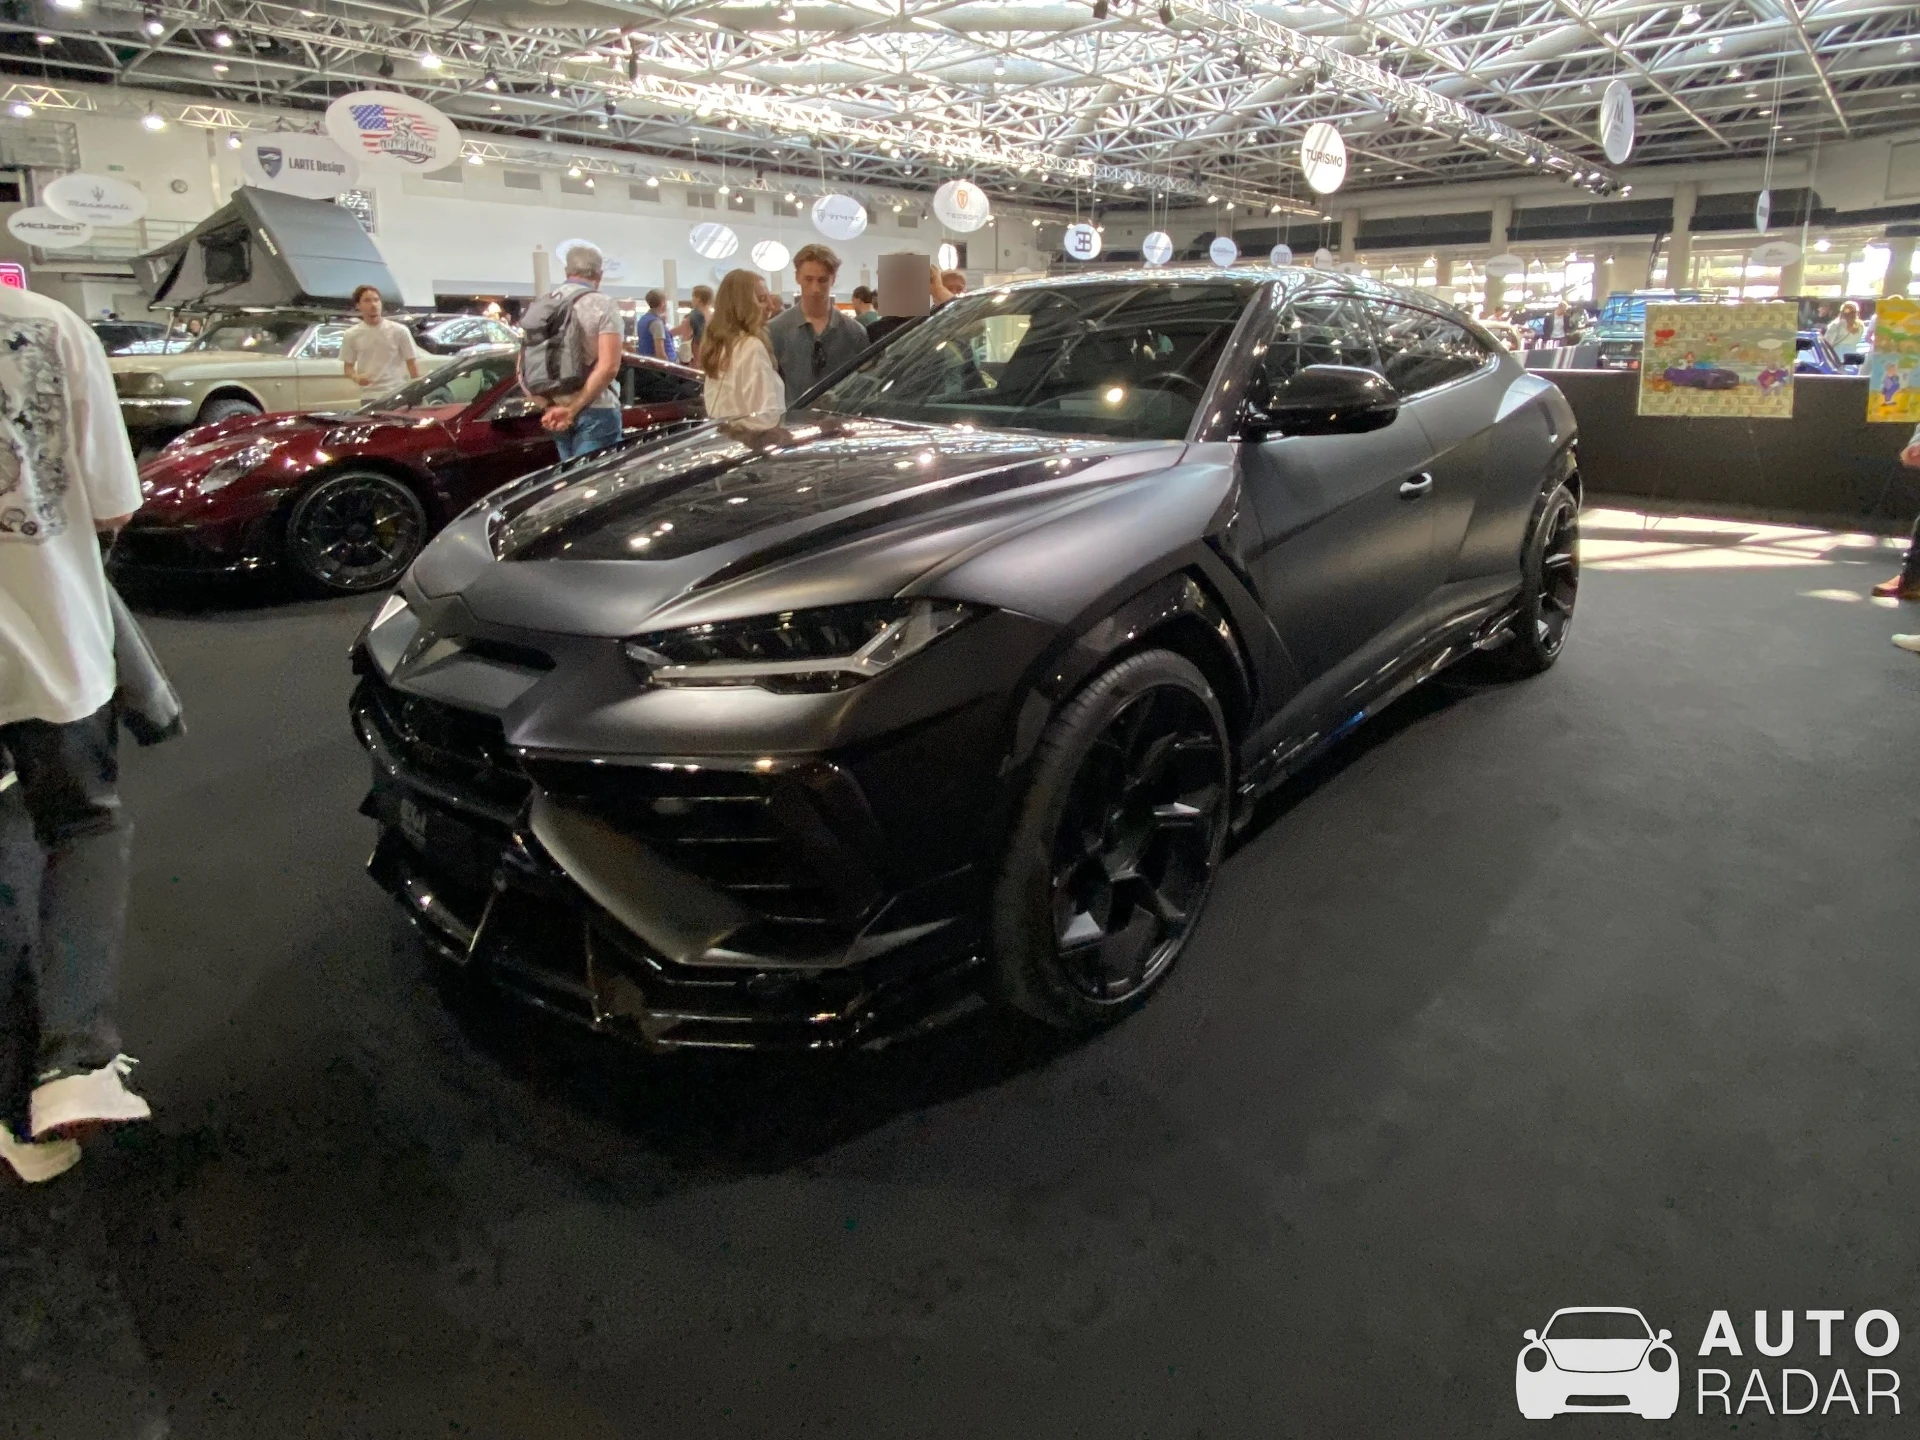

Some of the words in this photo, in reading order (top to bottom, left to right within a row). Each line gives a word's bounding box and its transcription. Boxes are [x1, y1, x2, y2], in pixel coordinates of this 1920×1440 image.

[289, 158, 315, 170] LARTE
[316, 161, 346, 175] Design
[1306, 148, 1343, 167] TURISMO
